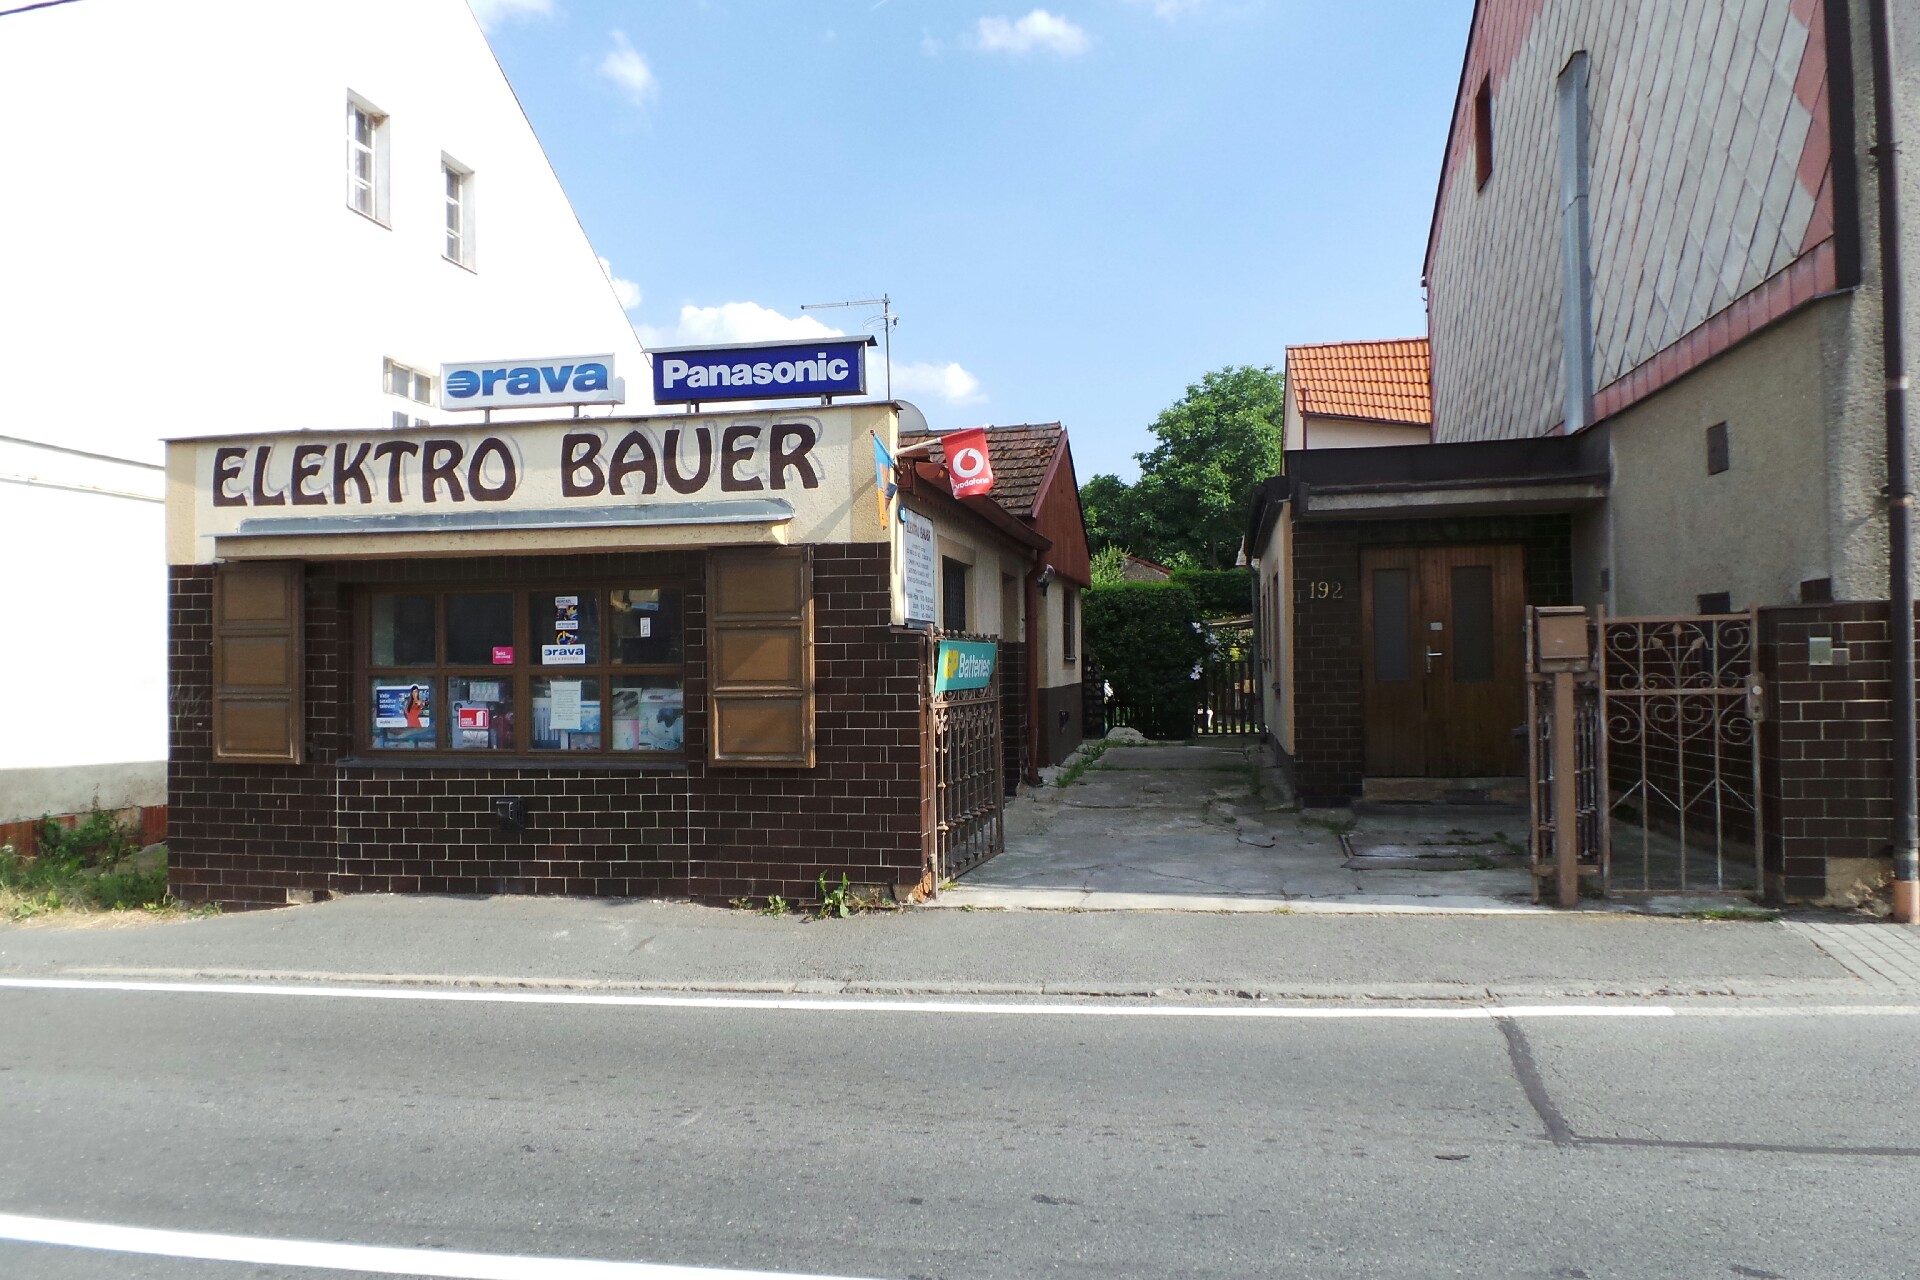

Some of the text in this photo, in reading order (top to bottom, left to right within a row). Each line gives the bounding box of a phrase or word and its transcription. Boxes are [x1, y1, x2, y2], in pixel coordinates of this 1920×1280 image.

[445, 362, 609, 399] orava
[661, 351, 850, 391] Panasonic
[211, 423, 819, 508] ELEKTRO BAUER
[955, 478, 990, 489] vodafone
[1309, 581, 1343, 599] 192
[544, 647, 584, 656] orava
[944, 650, 991, 679] GP Batteries
